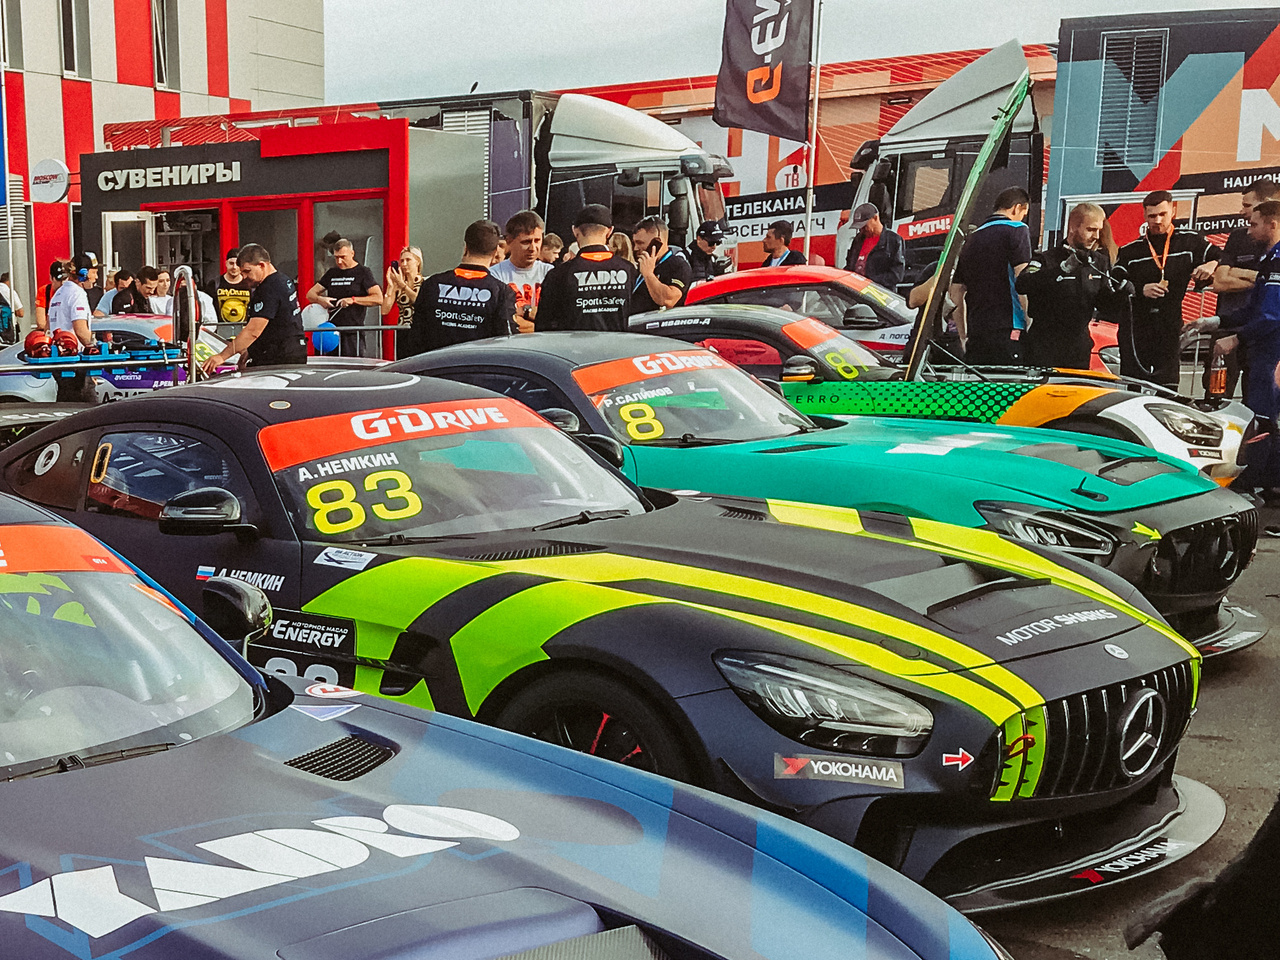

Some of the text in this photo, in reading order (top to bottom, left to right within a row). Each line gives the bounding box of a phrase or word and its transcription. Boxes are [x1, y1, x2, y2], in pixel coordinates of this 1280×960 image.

[97, 161, 241, 191] СУВЕНИРЫ
[908, 218, 951, 237] МАТЧ!
[438, 283, 492, 302] YADRO
[573, 270, 628, 286] YADRO
[619, 402, 665, 441] 8
[297, 452, 400, 482] А.НЕМКИН
[306, 470, 423, 535] 83
[996, 609, 1118, 646] MOTOR SHARKS
[810, 760, 897, 782] YOKOHAMA
